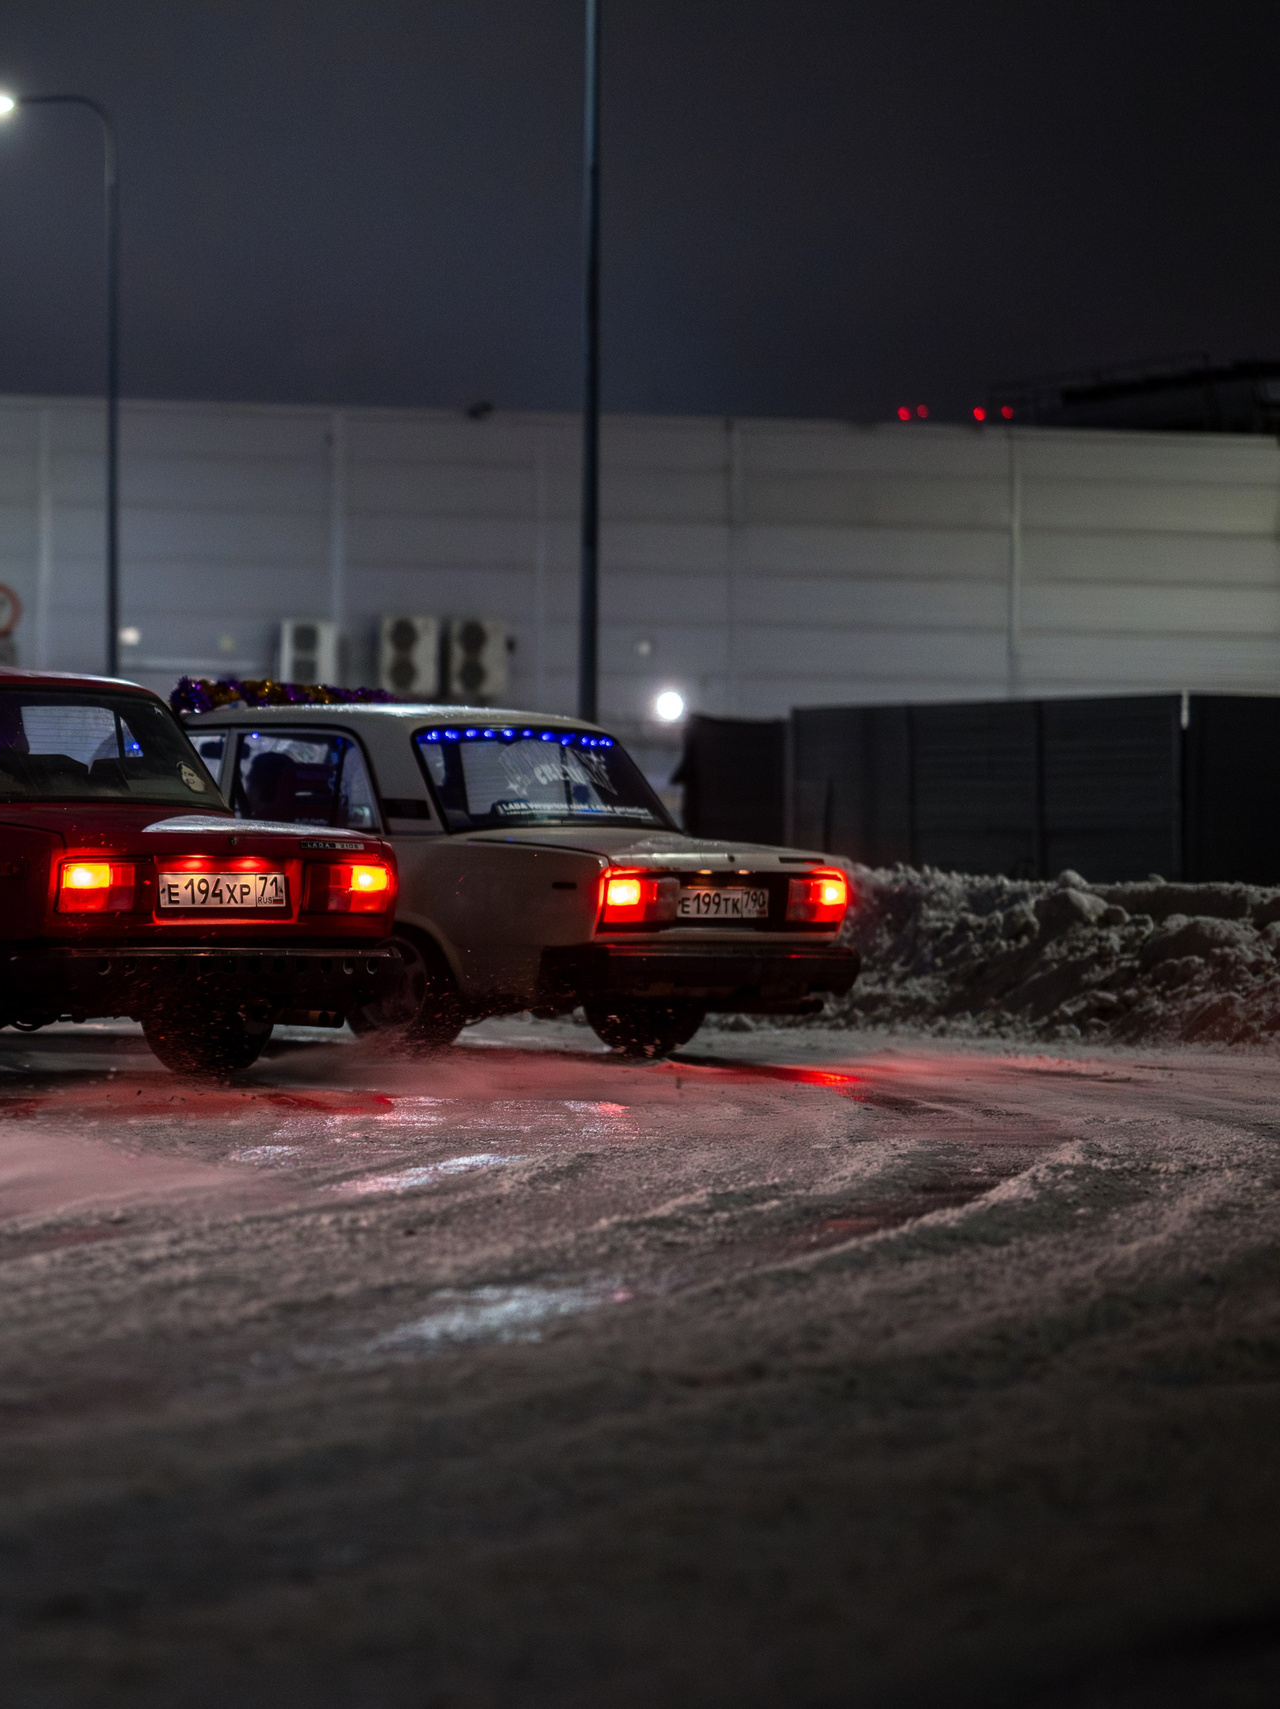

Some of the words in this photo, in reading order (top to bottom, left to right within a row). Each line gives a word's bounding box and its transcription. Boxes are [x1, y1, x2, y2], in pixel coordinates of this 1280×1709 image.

[167, 878, 251, 904] Е194ХР
[258, 876, 279, 897] 71
[681, 892, 740, 914] Е199ТК
[744, 891, 766, 908] 790
